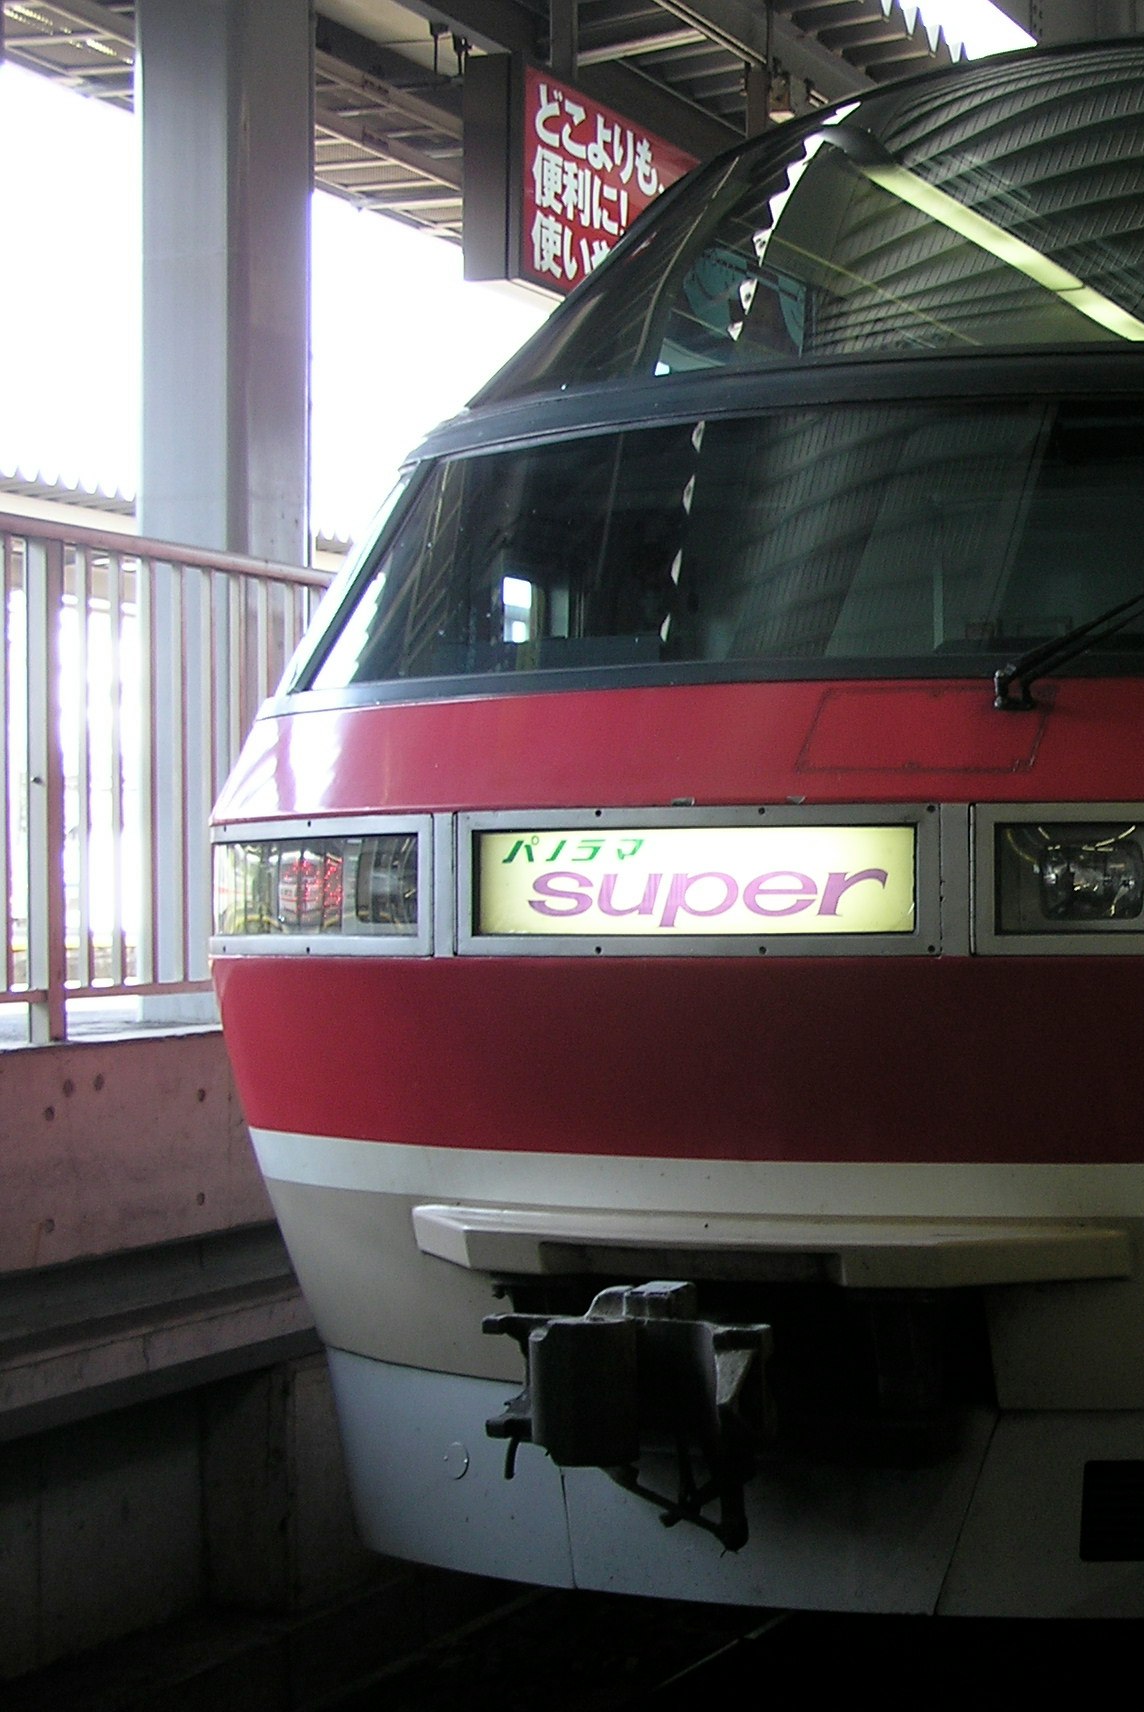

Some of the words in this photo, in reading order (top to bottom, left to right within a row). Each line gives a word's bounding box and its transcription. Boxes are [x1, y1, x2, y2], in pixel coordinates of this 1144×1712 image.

[502, 835, 645, 864] パノラマ
[528, 868, 888, 928] super
